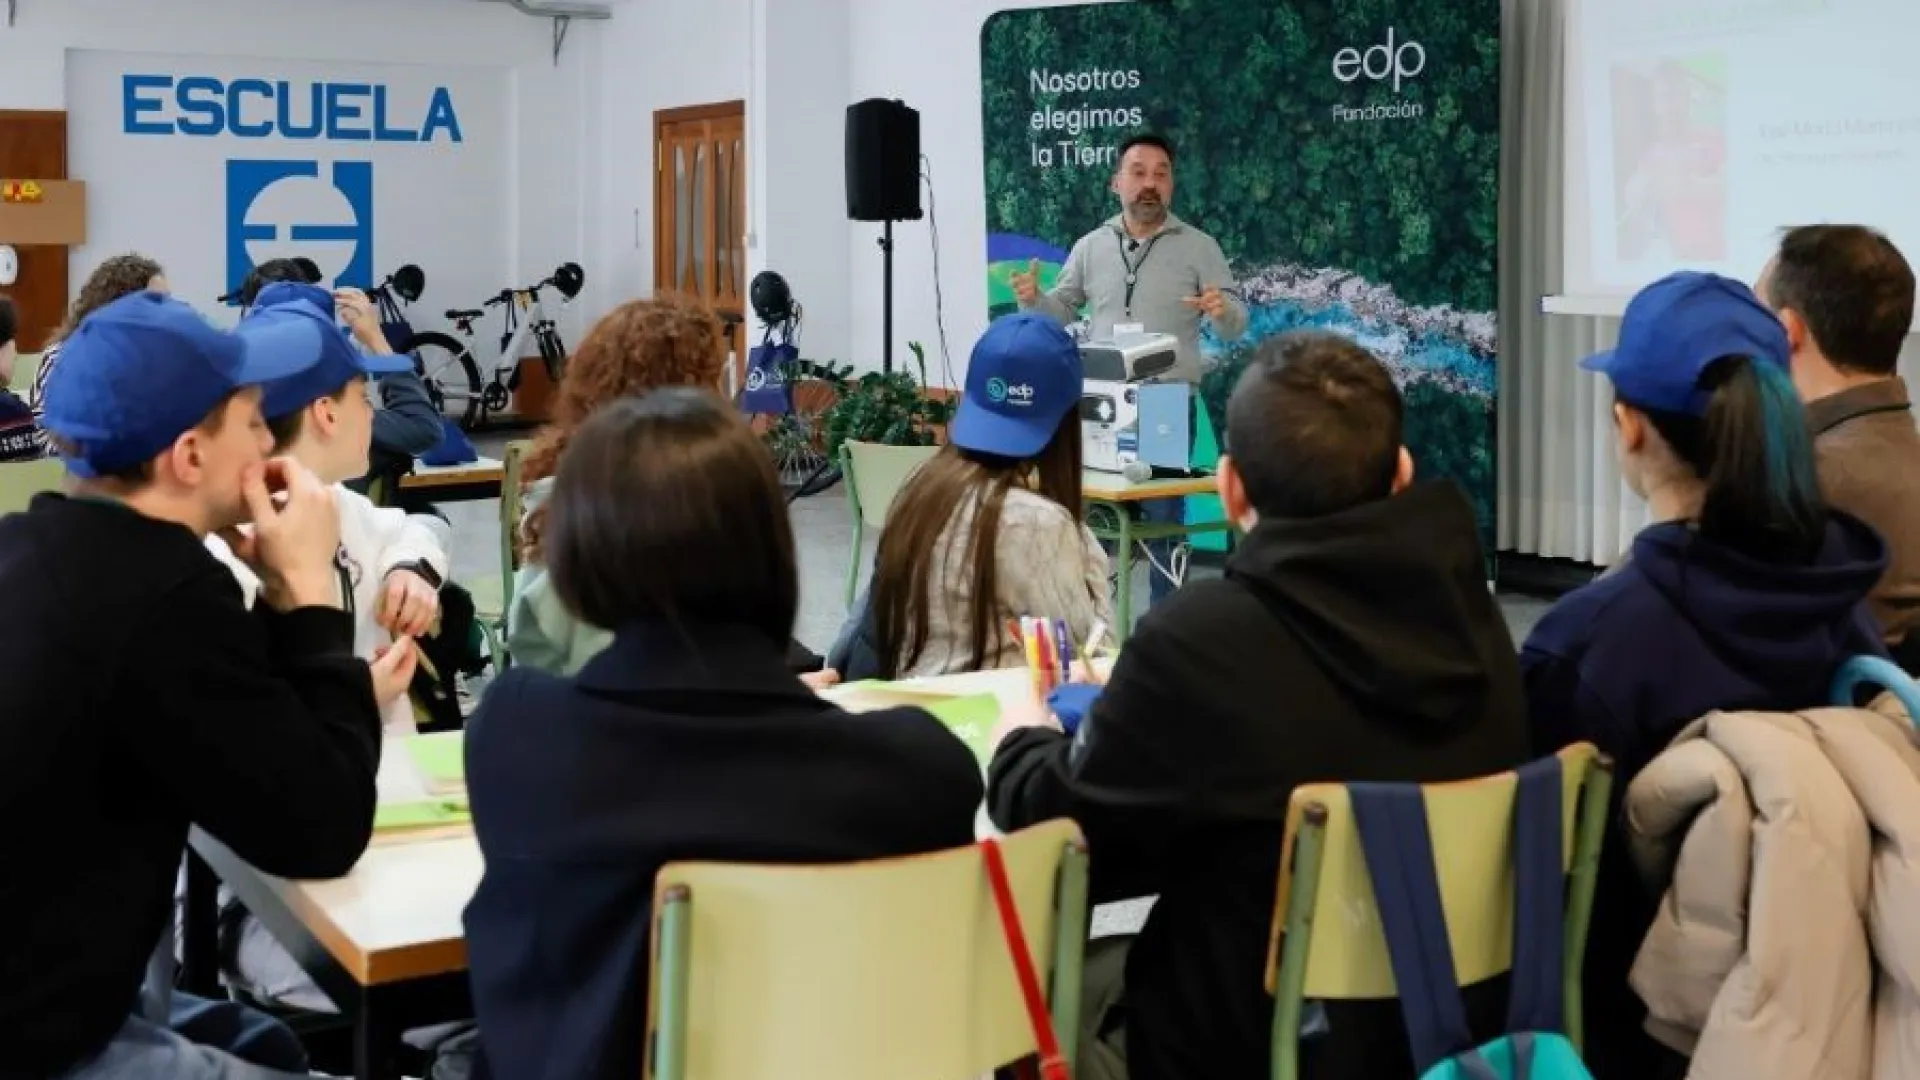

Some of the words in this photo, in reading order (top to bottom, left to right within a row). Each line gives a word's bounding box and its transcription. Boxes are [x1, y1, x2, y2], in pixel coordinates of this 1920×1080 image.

[1332, 26, 1426, 93] edp
[1030, 67, 1140, 94] Nosotros
[123, 74, 463, 142] ESCUELA
[1030, 102, 1142, 135] elegimos
[1332, 100, 1423, 122] Fundación
[1031, 142, 1053, 167] la
[1058, 140, 1119, 166] Tierr
[1008, 383, 1034, 400] edp
